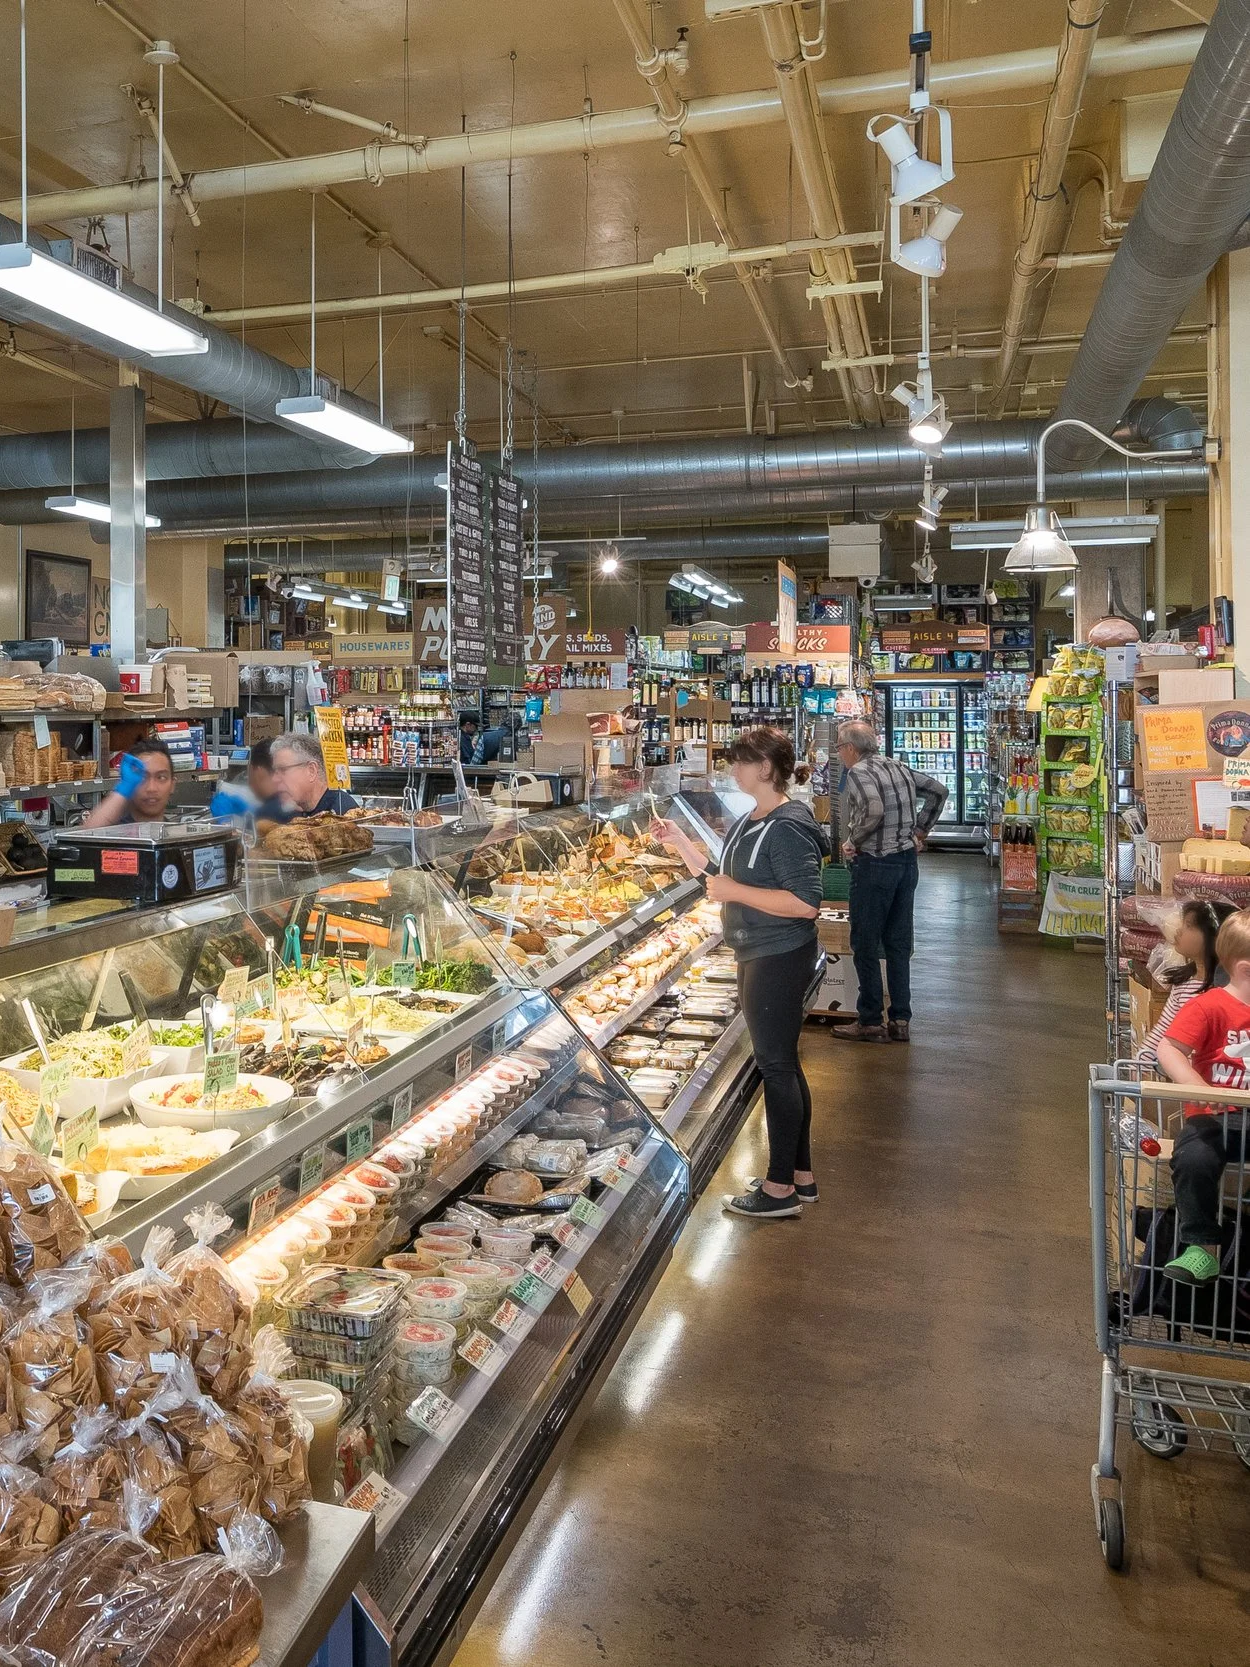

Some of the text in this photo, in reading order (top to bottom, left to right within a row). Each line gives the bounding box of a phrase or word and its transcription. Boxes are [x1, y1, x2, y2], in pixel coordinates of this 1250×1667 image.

[691, 633, 717, 641] AISLE
[914, 632, 942, 640] AISLE
[340, 641, 410, 652] HOUSEWARES
[583, 644, 612, 652] MIXES
[767, 637, 827, 651] SCKS
[1145, 717, 1172, 728] PRIMA
[1210, 719, 1231, 731] Prima
[1162, 725, 1196, 734] DONNA
[1077, 884, 1100, 896] CRUZ
